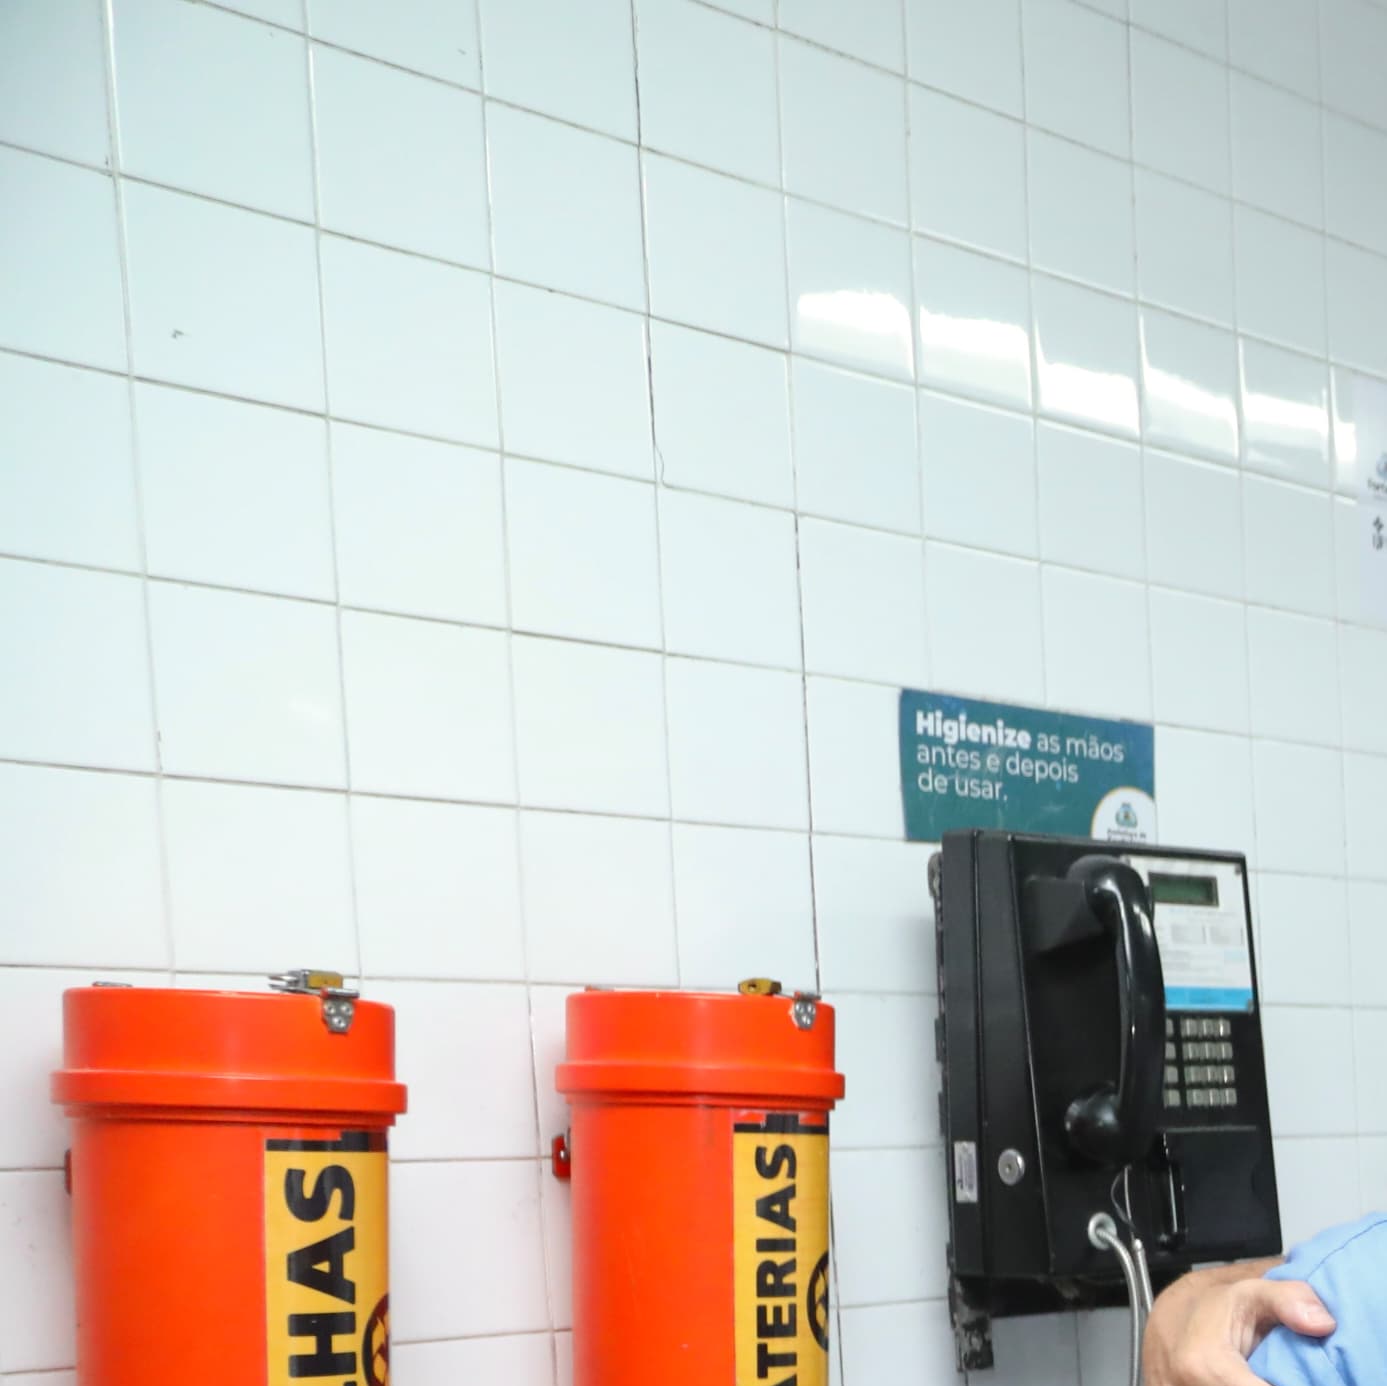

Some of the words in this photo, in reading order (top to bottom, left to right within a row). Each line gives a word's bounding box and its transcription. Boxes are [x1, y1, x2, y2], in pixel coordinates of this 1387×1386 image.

[916, 710, 1031, 750] Higienize
[1037, 733, 1061, 754] as
[1066, 735, 1125, 764] mãos
[917, 744, 980, 772] antes
[986, 754, 1000, 773] e
[1006, 752, 1079, 784] depois
[918, 768, 948, 795] de
